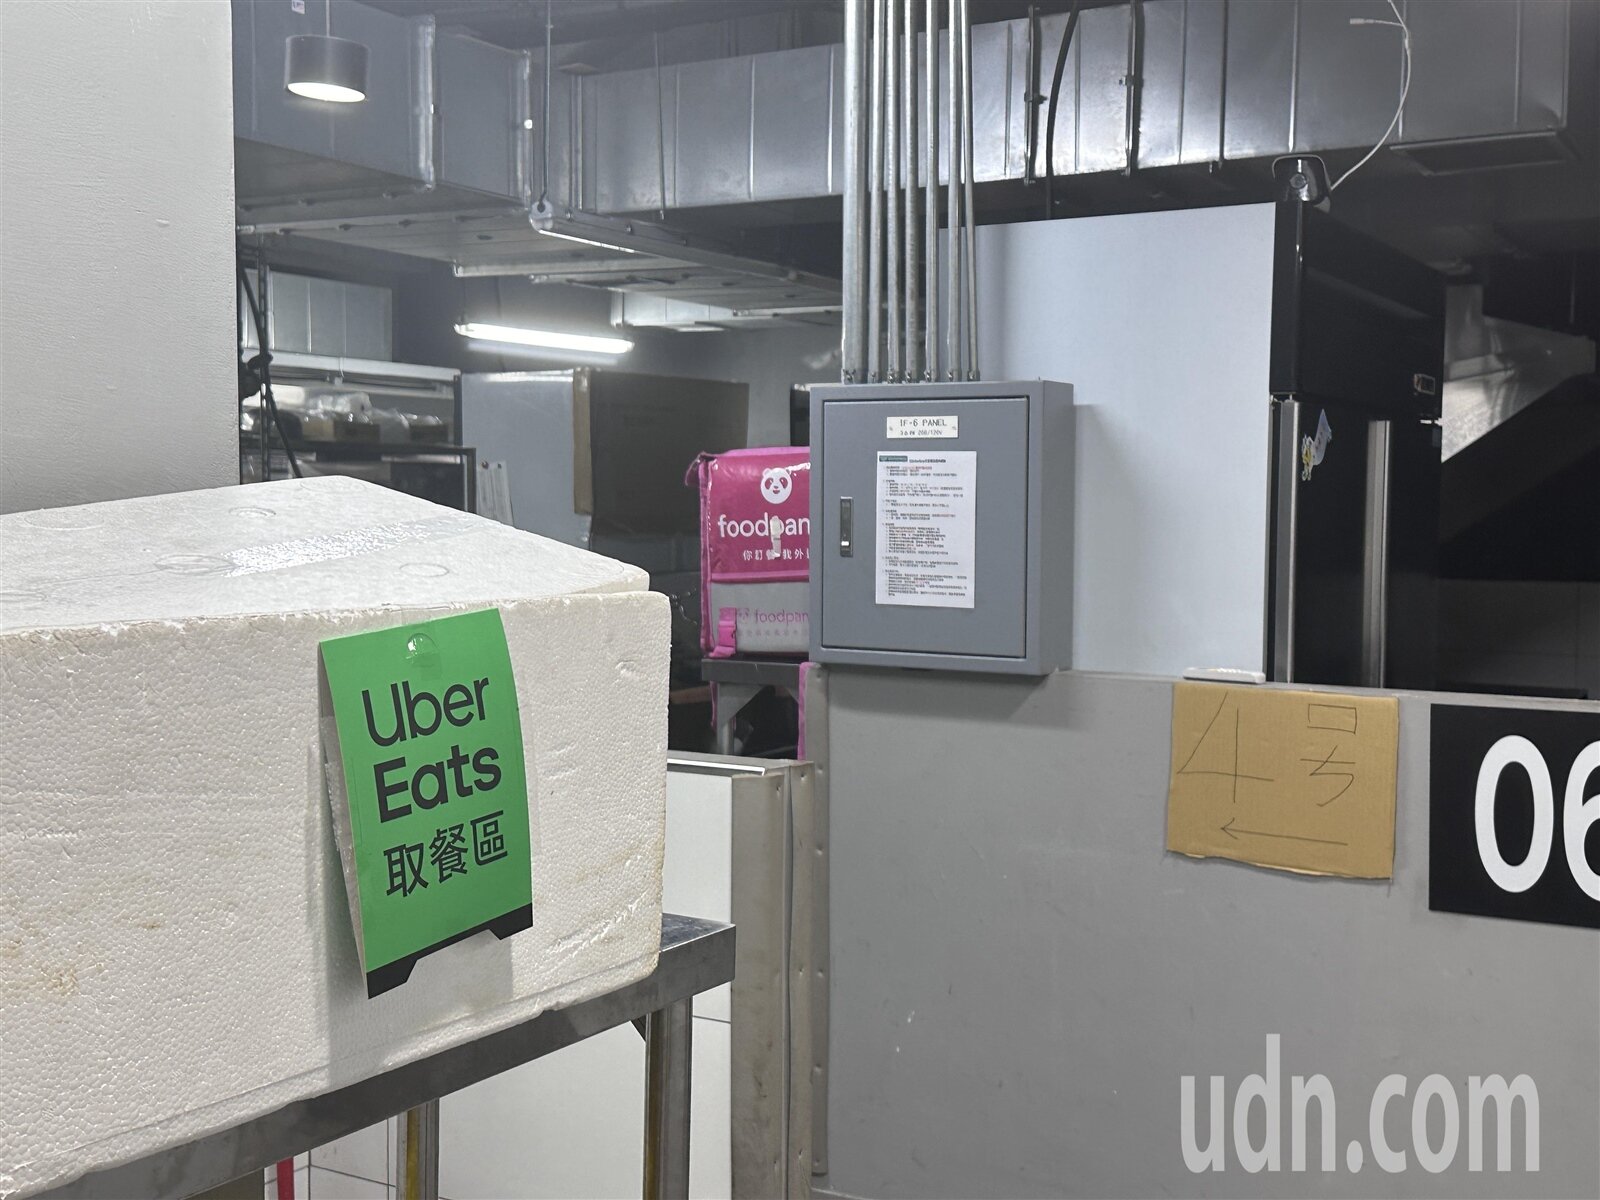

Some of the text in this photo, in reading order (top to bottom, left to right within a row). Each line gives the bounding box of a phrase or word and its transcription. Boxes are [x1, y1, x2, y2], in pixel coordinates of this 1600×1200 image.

[922, 418, 948, 427] PANEL
[361, 677, 489, 747] Uber
[373, 744, 502, 823] Eats
[383, 810, 508, 897] 取餐區
